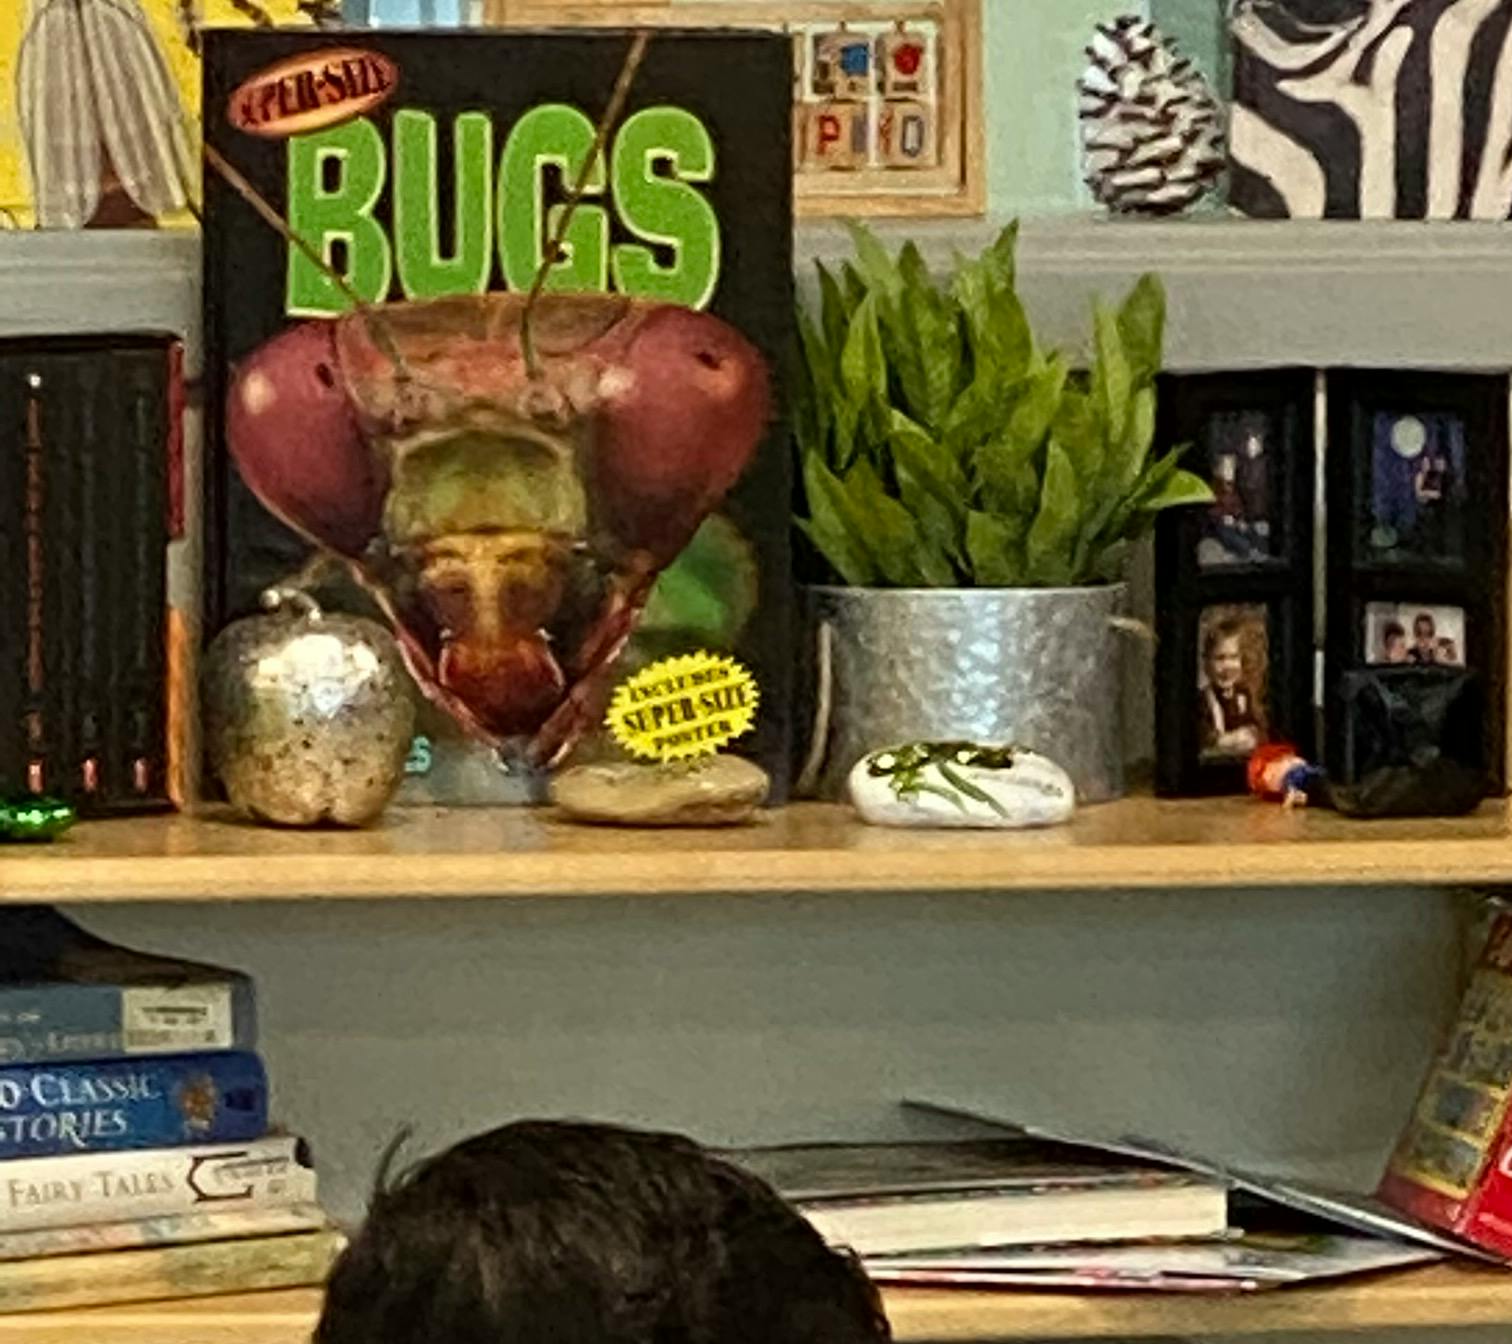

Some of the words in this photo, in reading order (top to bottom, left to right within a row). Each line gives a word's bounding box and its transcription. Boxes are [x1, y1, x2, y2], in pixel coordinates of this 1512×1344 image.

[285, 103, 721, 318] BUGS
[622, 685, 746, 736] SUPER-SIZE
[30, 1071, 164, 1110] CLASSIC
[0, 1107, 129, 1149] TORIES
[7, 1175, 85, 1206] FAIRY
[93, 1165, 177, 1198] TALES
